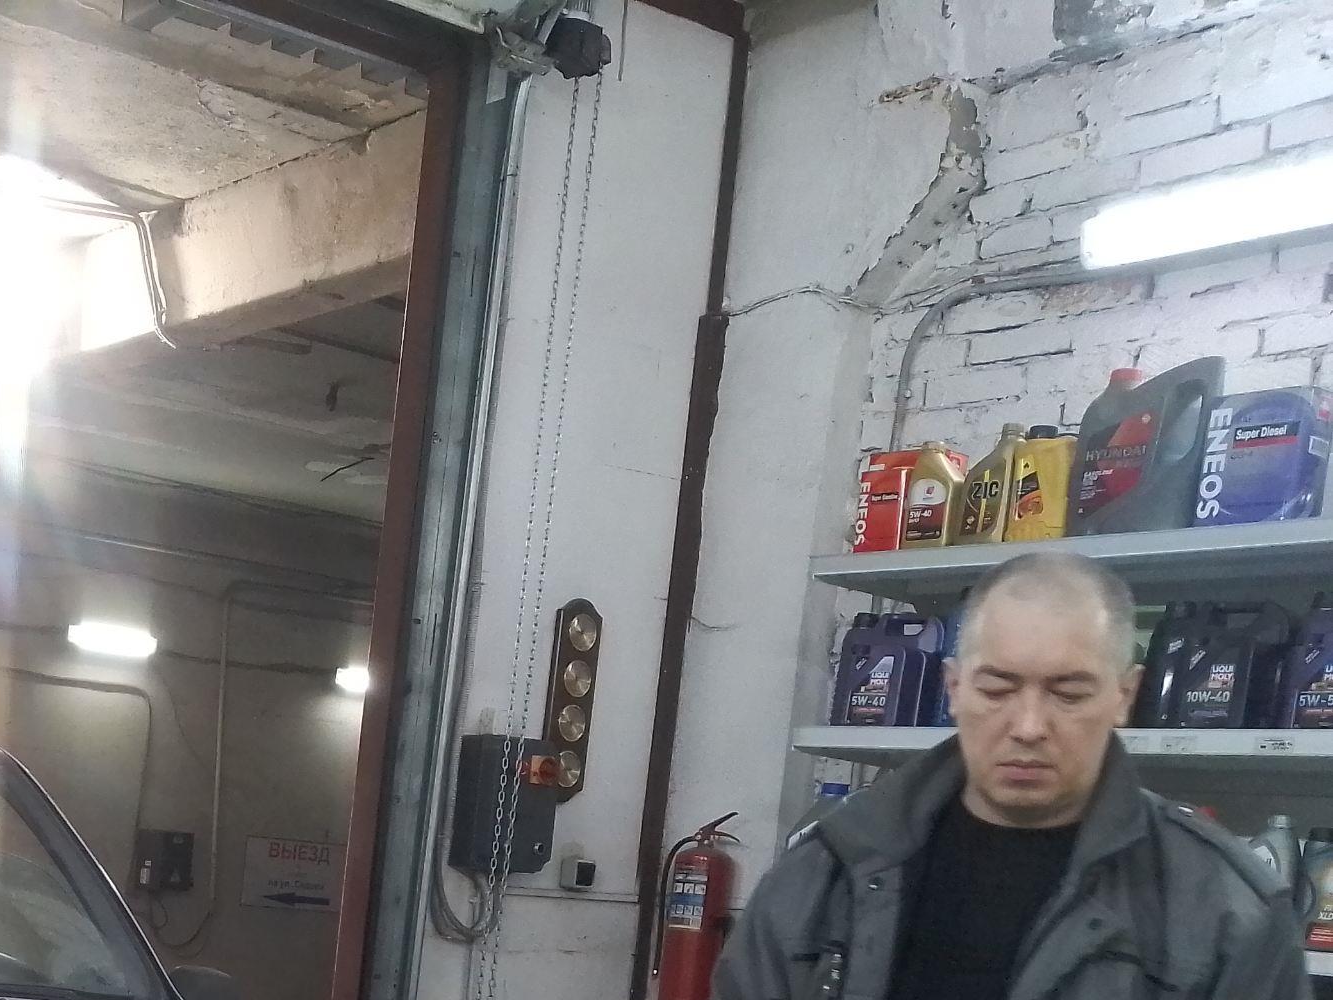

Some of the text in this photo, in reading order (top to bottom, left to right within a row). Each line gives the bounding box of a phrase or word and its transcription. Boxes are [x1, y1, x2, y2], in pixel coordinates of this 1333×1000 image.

[1235, 424, 1288, 442] Super Diesel
[1085, 445, 1147, 462] HYUNDAI
[1196, 407, 1234, 519] ENEOS
[970, 480, 1001, 499] ZIC
[855, 481, 872, 546] ENEOS
[1210, 673, 1234, 681] MOLY
[1211, 664, 1234, 673] LIQUI
[851, 695, 886, 707] 5W-40
[1186, 691, 1230, 703] 10W-40
[267, 841, 330, 865] ВЫЕЗД
